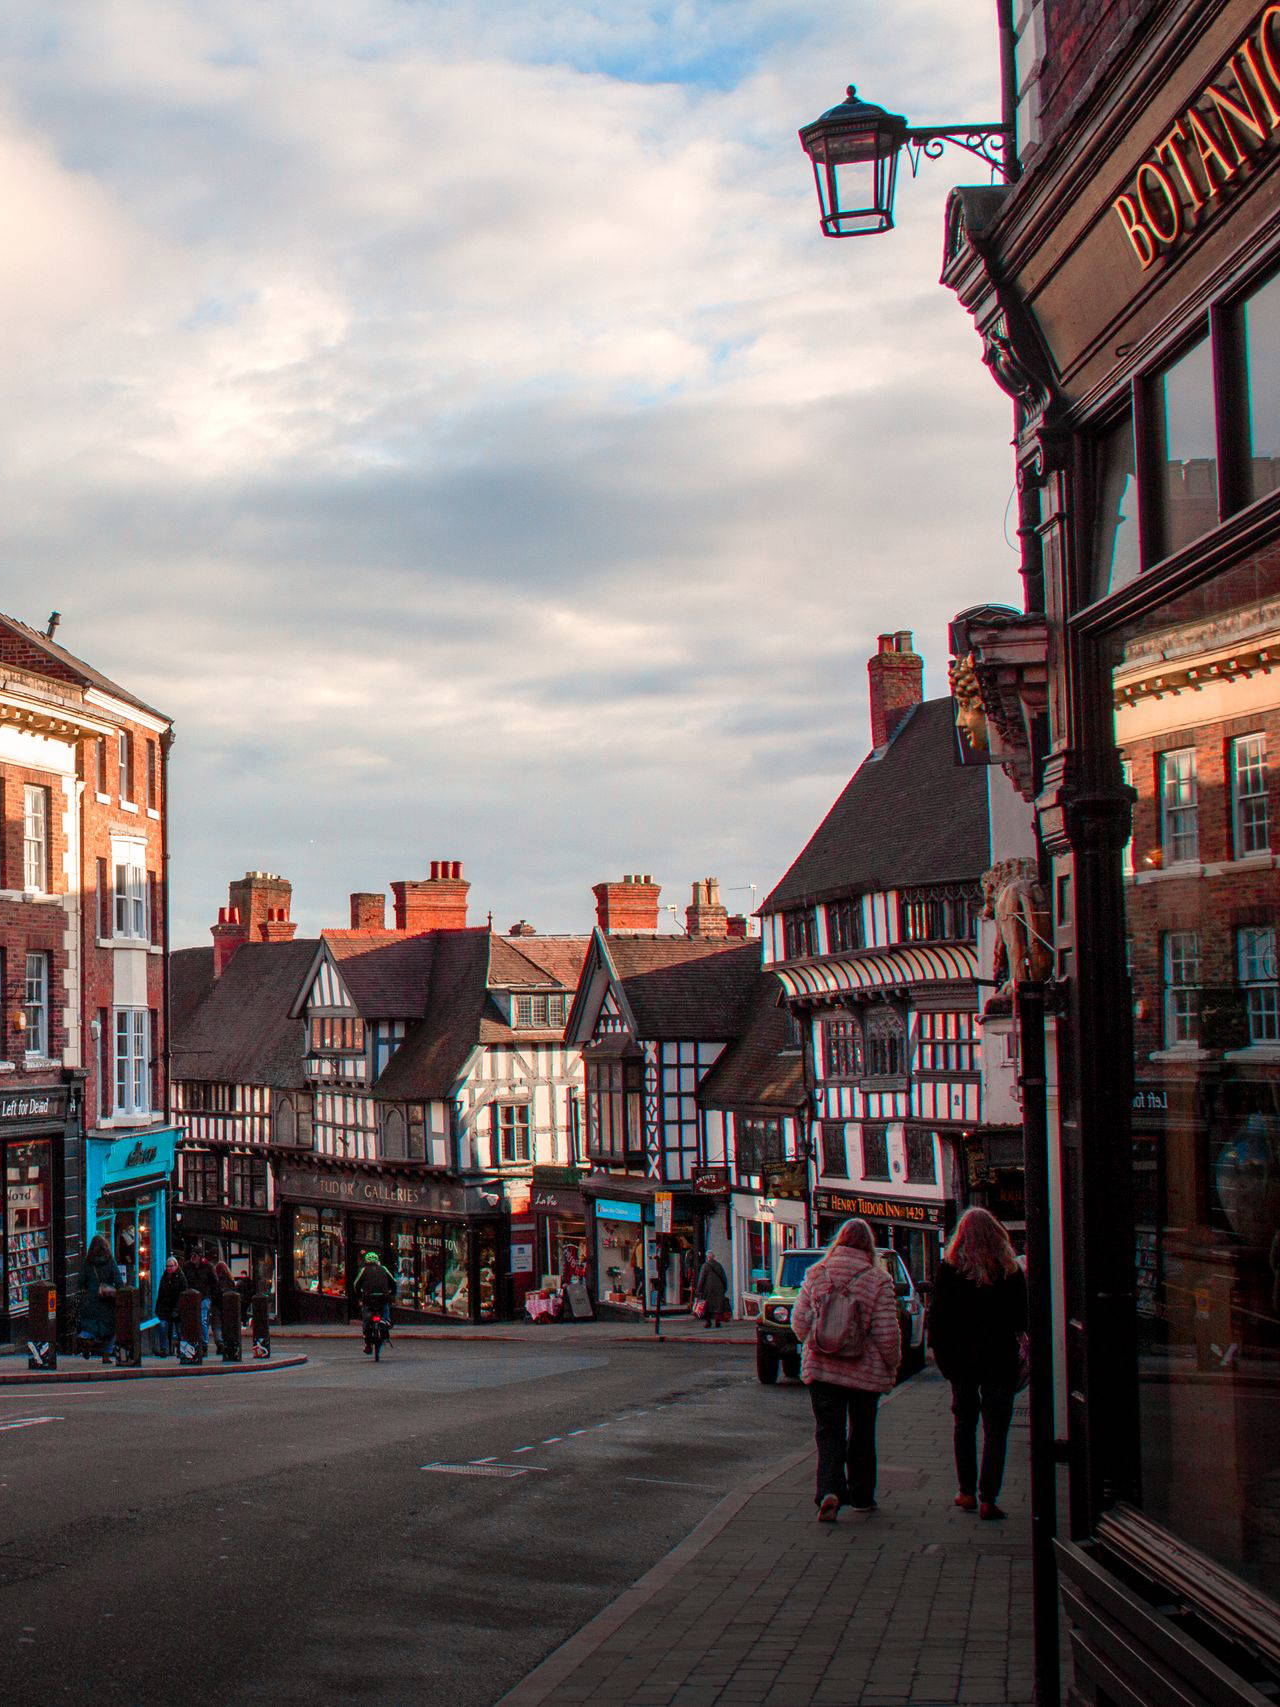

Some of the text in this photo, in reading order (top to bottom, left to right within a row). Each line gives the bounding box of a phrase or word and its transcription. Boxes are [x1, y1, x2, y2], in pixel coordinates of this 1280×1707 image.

[2, 1098, 49, 1117] Left for Dead
[320, 1180, 419, 1203] TUDOR GALLERIES
[831, 1194, 857, 1213] HENRY
[857, 1198, 884, 1216] TUDOR
[884, 1202, 900, 1217] INN
[905, 1207, 925, 1220] 1429
